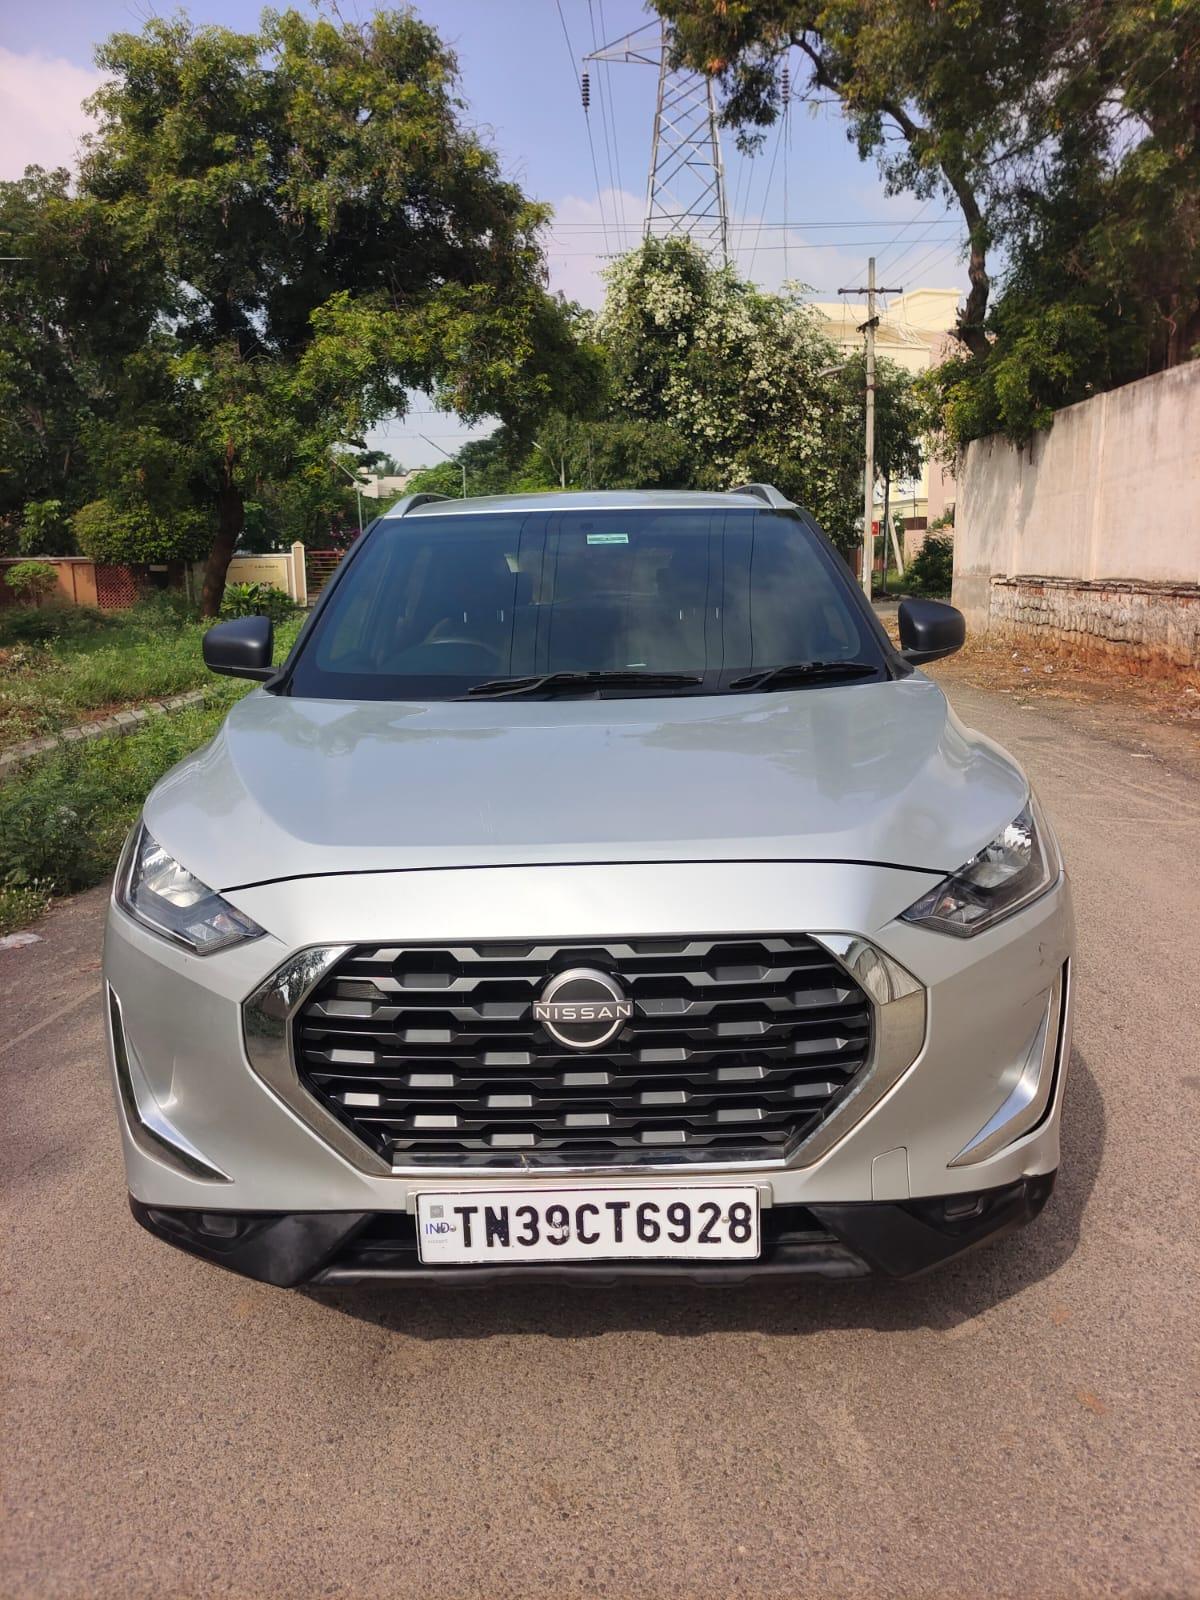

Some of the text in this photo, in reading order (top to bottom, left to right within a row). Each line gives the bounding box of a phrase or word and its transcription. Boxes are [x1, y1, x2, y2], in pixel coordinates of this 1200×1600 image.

[536, 1004, 631, 1020] NISSAN
[425, 1222, 450, 1235] IND
[453, 1200, 752, 1249] TN39CT6928
